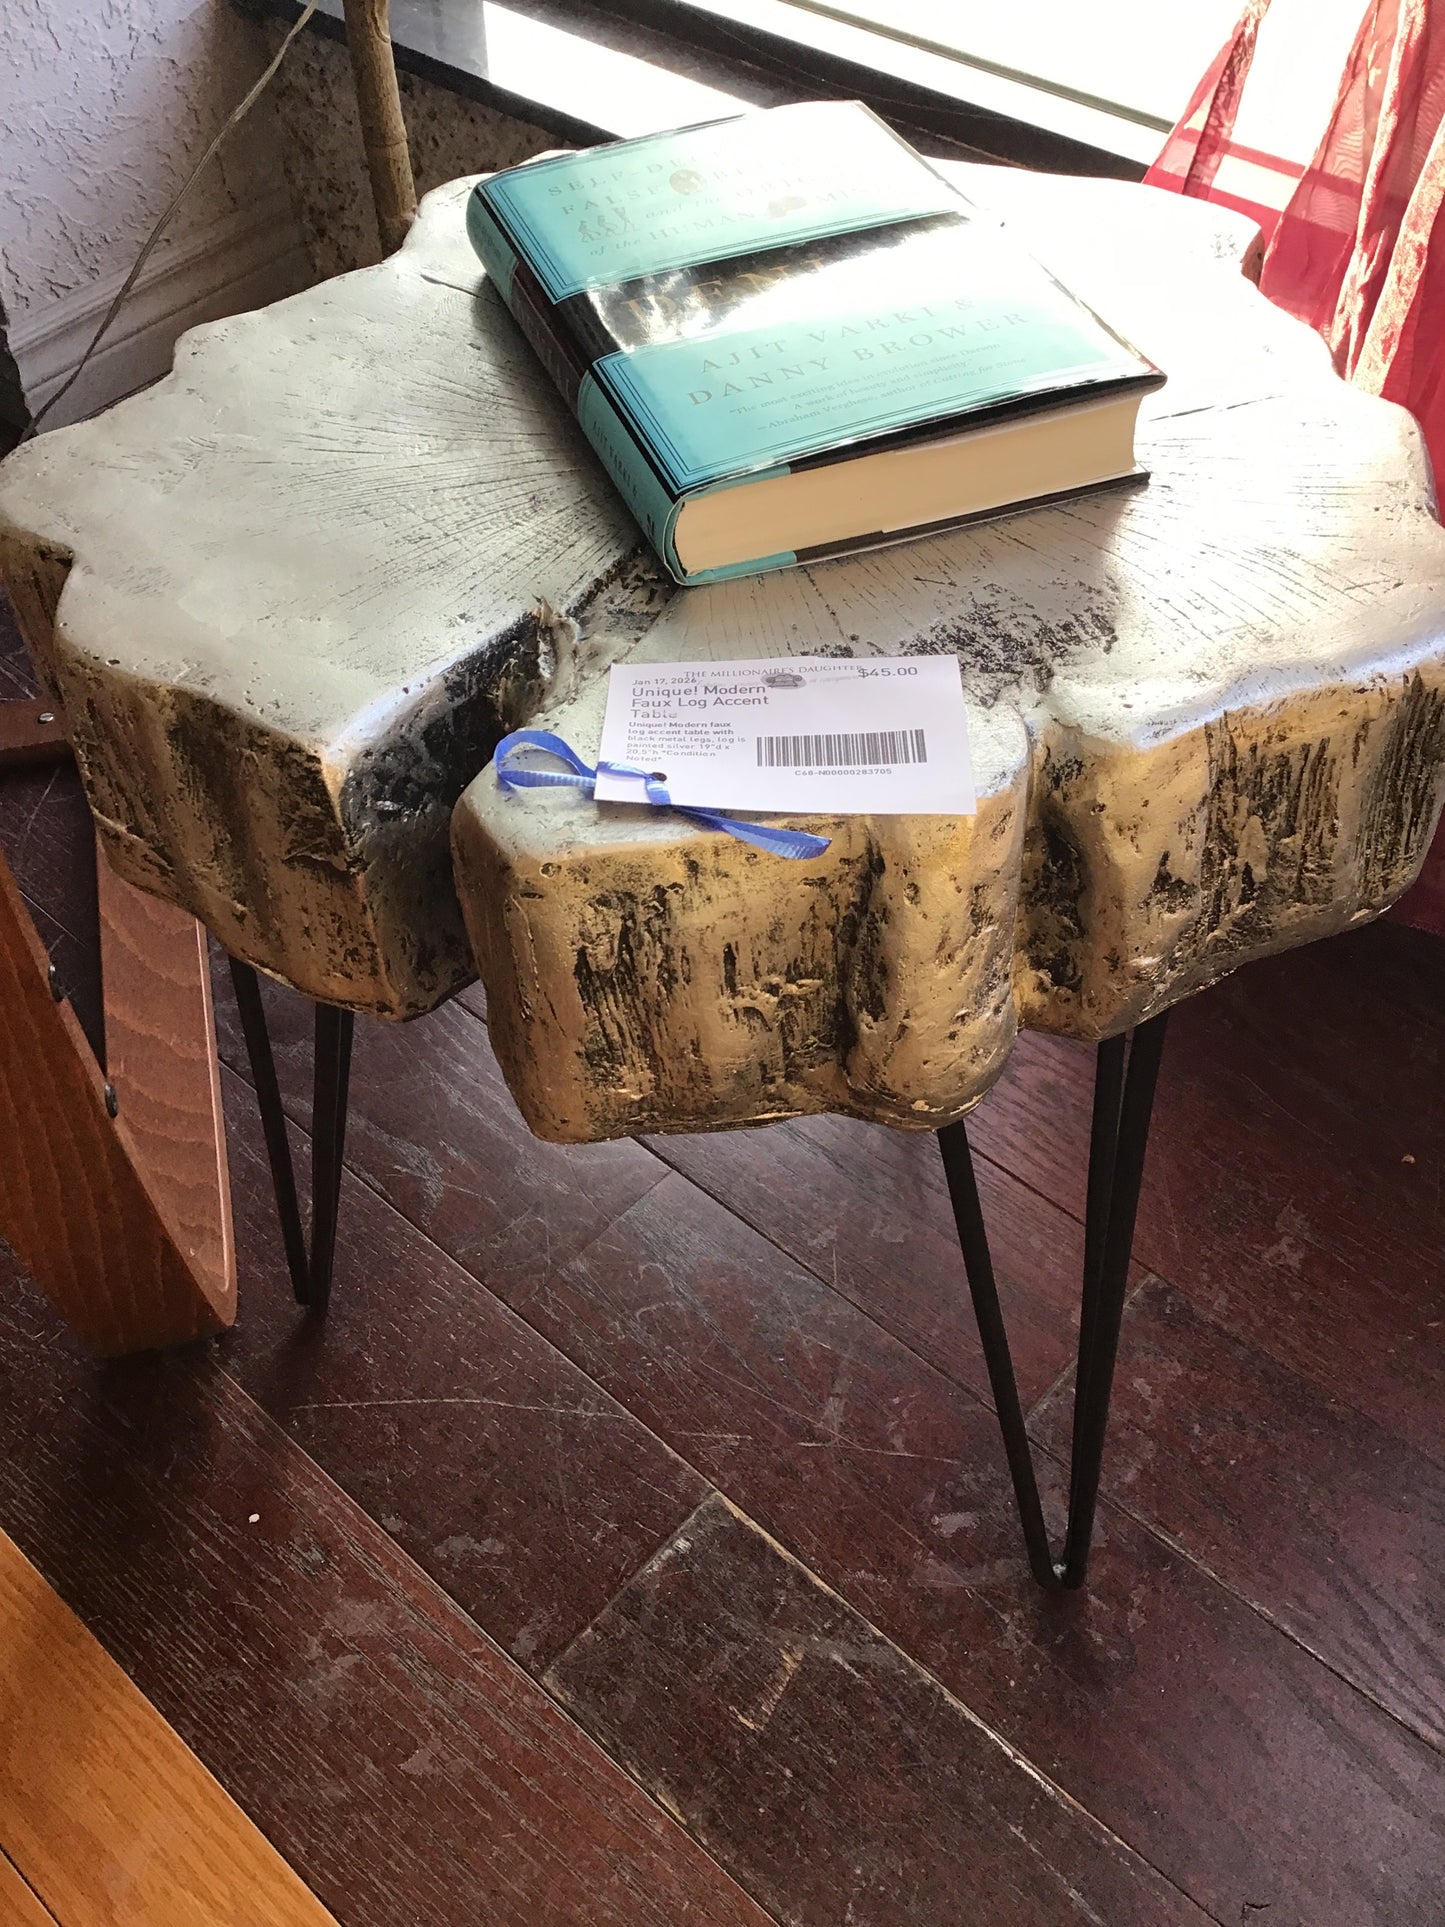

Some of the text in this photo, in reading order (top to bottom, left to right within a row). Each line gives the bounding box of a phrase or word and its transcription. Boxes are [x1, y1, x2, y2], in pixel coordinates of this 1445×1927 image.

[700, 295, 976, 373] AJIT VARKI &
[687, 312, 1030, 406] DANNY BROWER
[760, 395, 787, 408] most
[790, 383, 836, 400] exciting
[805, 395, 834, 407] work
[684, 670, 707, 678] THE
[798, 665, 863, 674] DAUGHTER
[858, 666, 918, 679] $45.00
[632, 685, 698, 698] Unique!
[703, 685, 766, 695] Modern
[631, 695, 770, 709] Faux Log Accent
[630, 708, 678, 719] Table
[627, 728, 645, 736] log
[626, 742, 664, 750] painted
[666, 742, 695, 750] silver
[658, 735, 687, 743] metal
[717, 736, 735, 744] log
